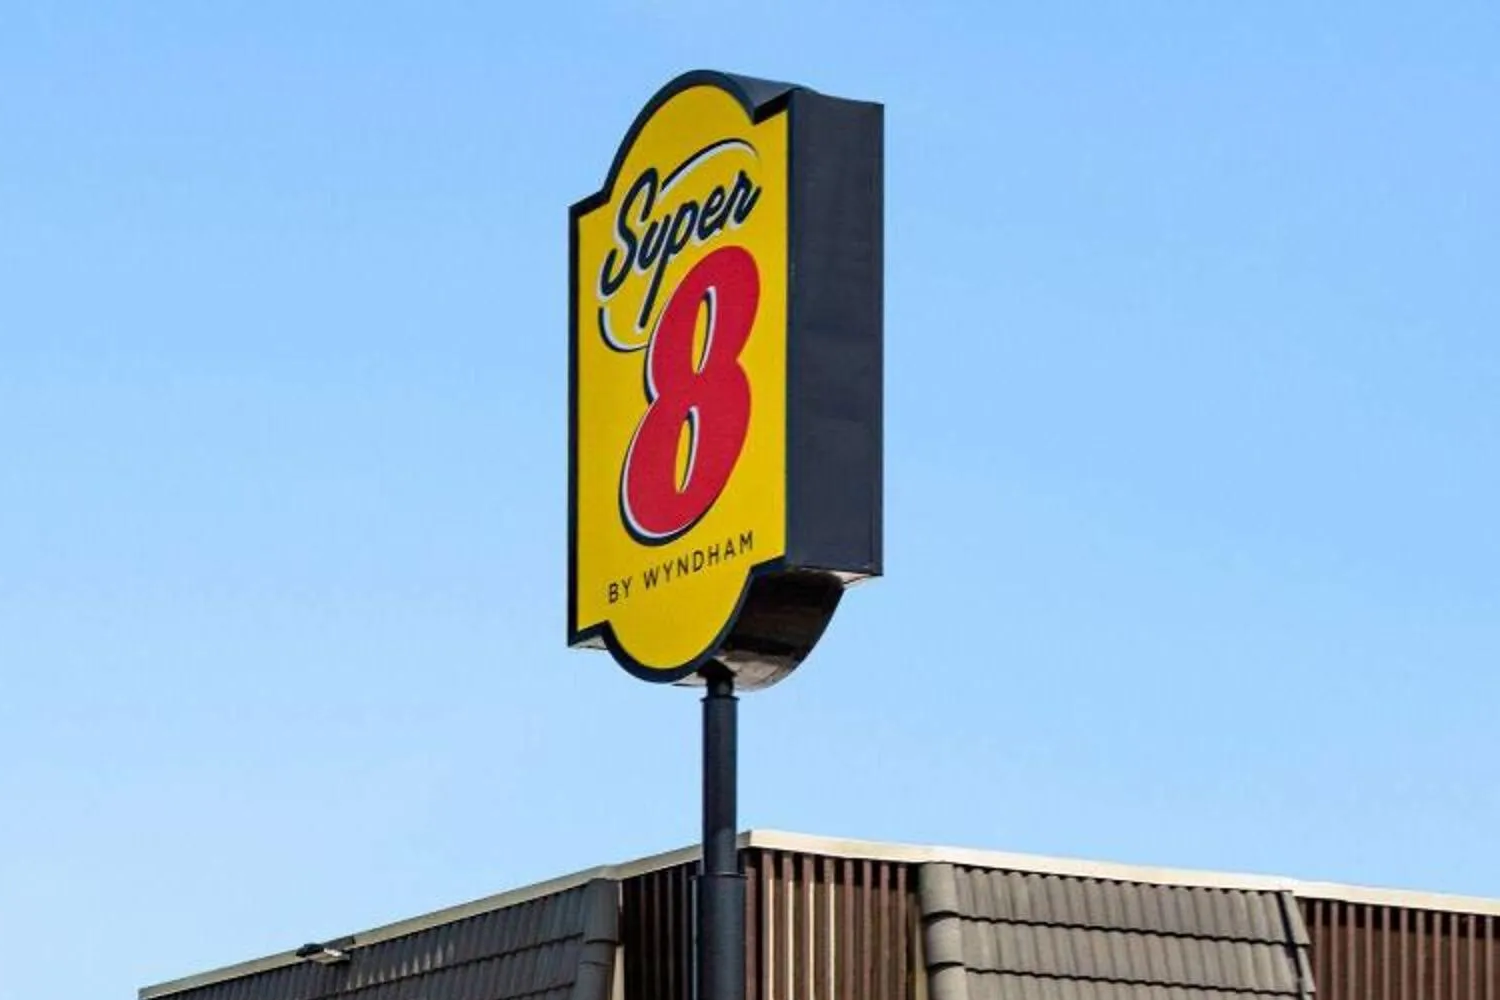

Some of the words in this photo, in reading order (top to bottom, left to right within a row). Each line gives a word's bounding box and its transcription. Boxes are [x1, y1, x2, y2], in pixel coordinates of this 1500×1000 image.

[599, 164, 762, 332] Super
[618, 245, 760, 546] 8
[607, 576, 632, 604] BY
[643, 531, 754, 591] WYNDHAM
